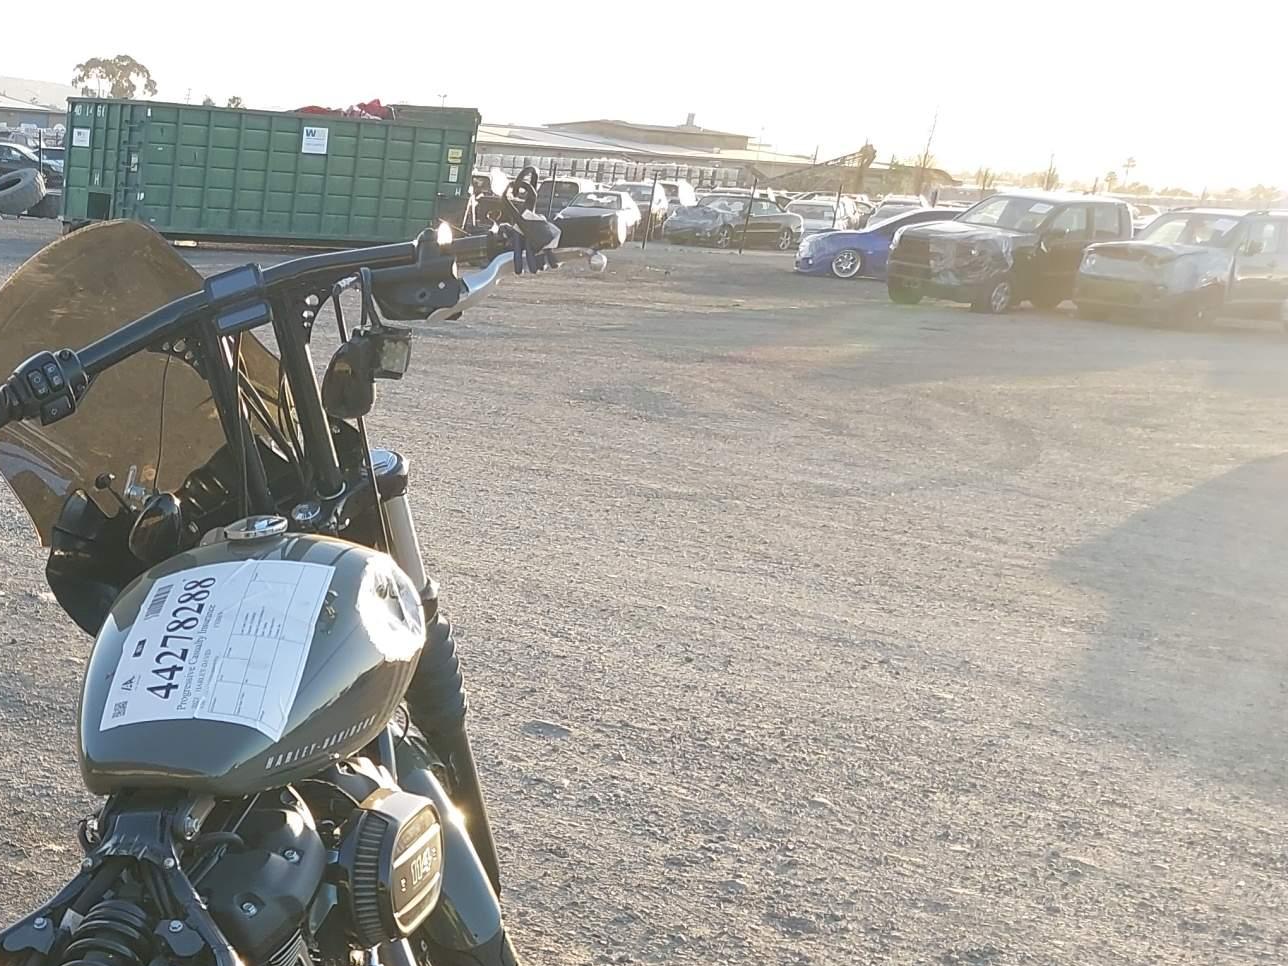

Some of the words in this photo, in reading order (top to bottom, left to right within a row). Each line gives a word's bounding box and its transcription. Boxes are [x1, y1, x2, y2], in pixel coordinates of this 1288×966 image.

[146, 576, 217, 699] 44278288
[176, 666, 197, 712] Progressive
[188, 635, 207, 666] Casualty
[410, 847, 432, 886] 114
